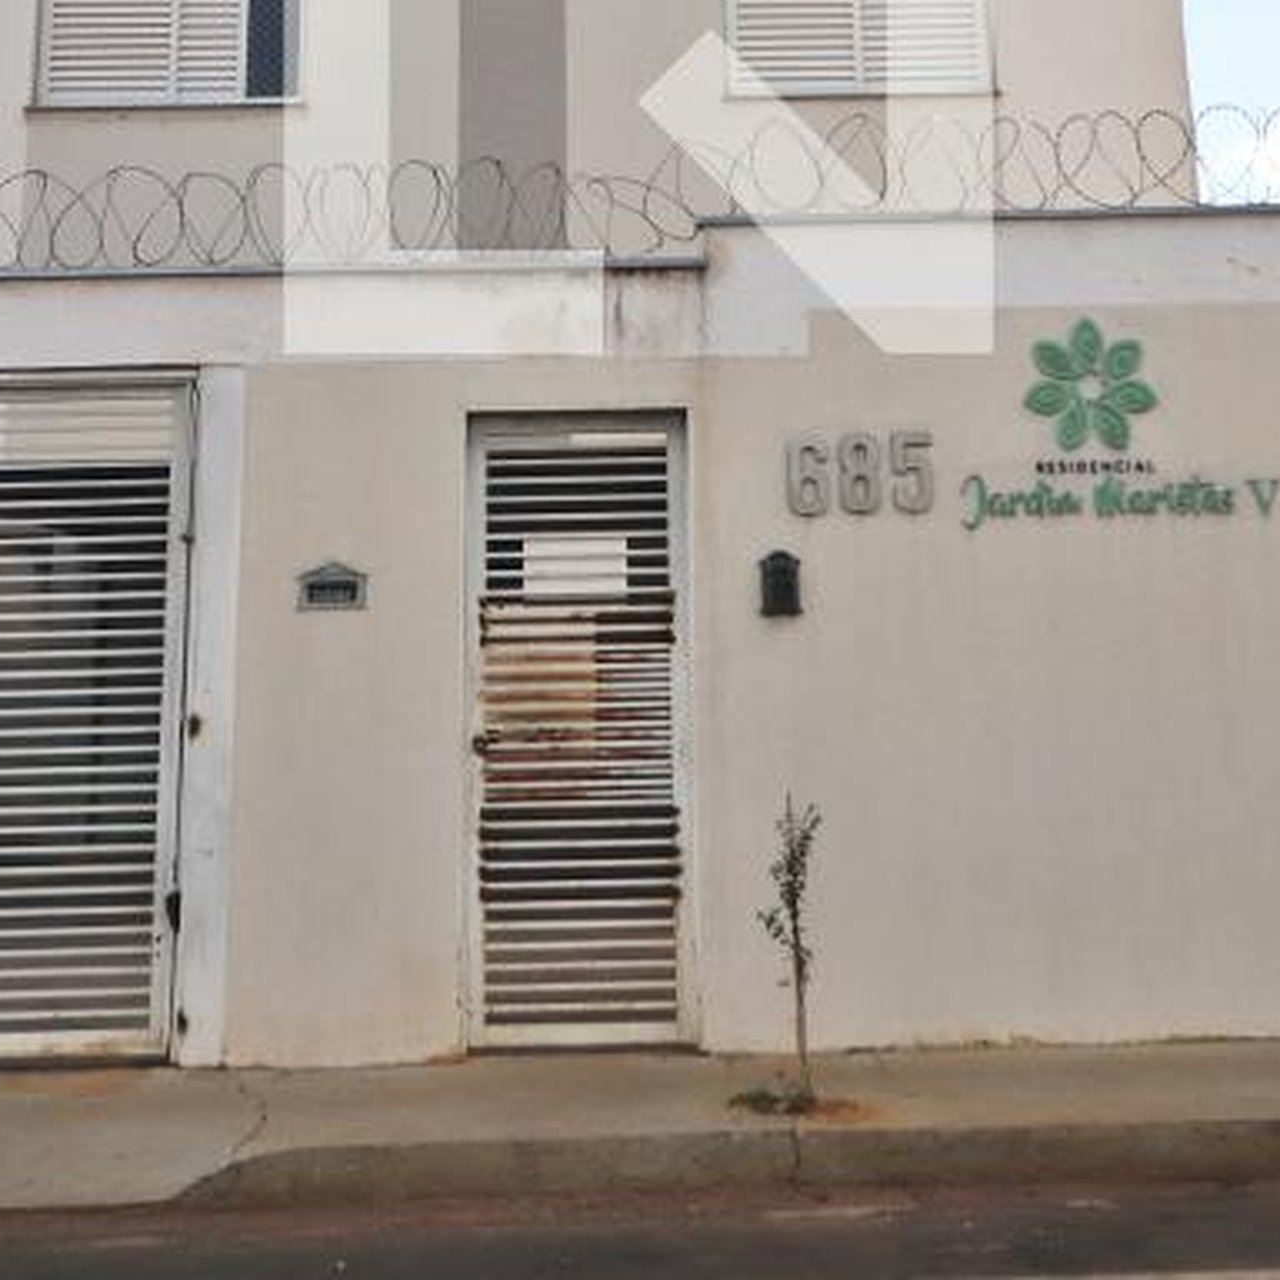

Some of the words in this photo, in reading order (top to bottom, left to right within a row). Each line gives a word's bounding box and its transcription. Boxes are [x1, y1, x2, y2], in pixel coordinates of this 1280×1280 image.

[784, 429, 935, 518] 685
[1035, 460, 1156, 475] RESIDENCIAL
[1245, 478, 1280, 519] V
